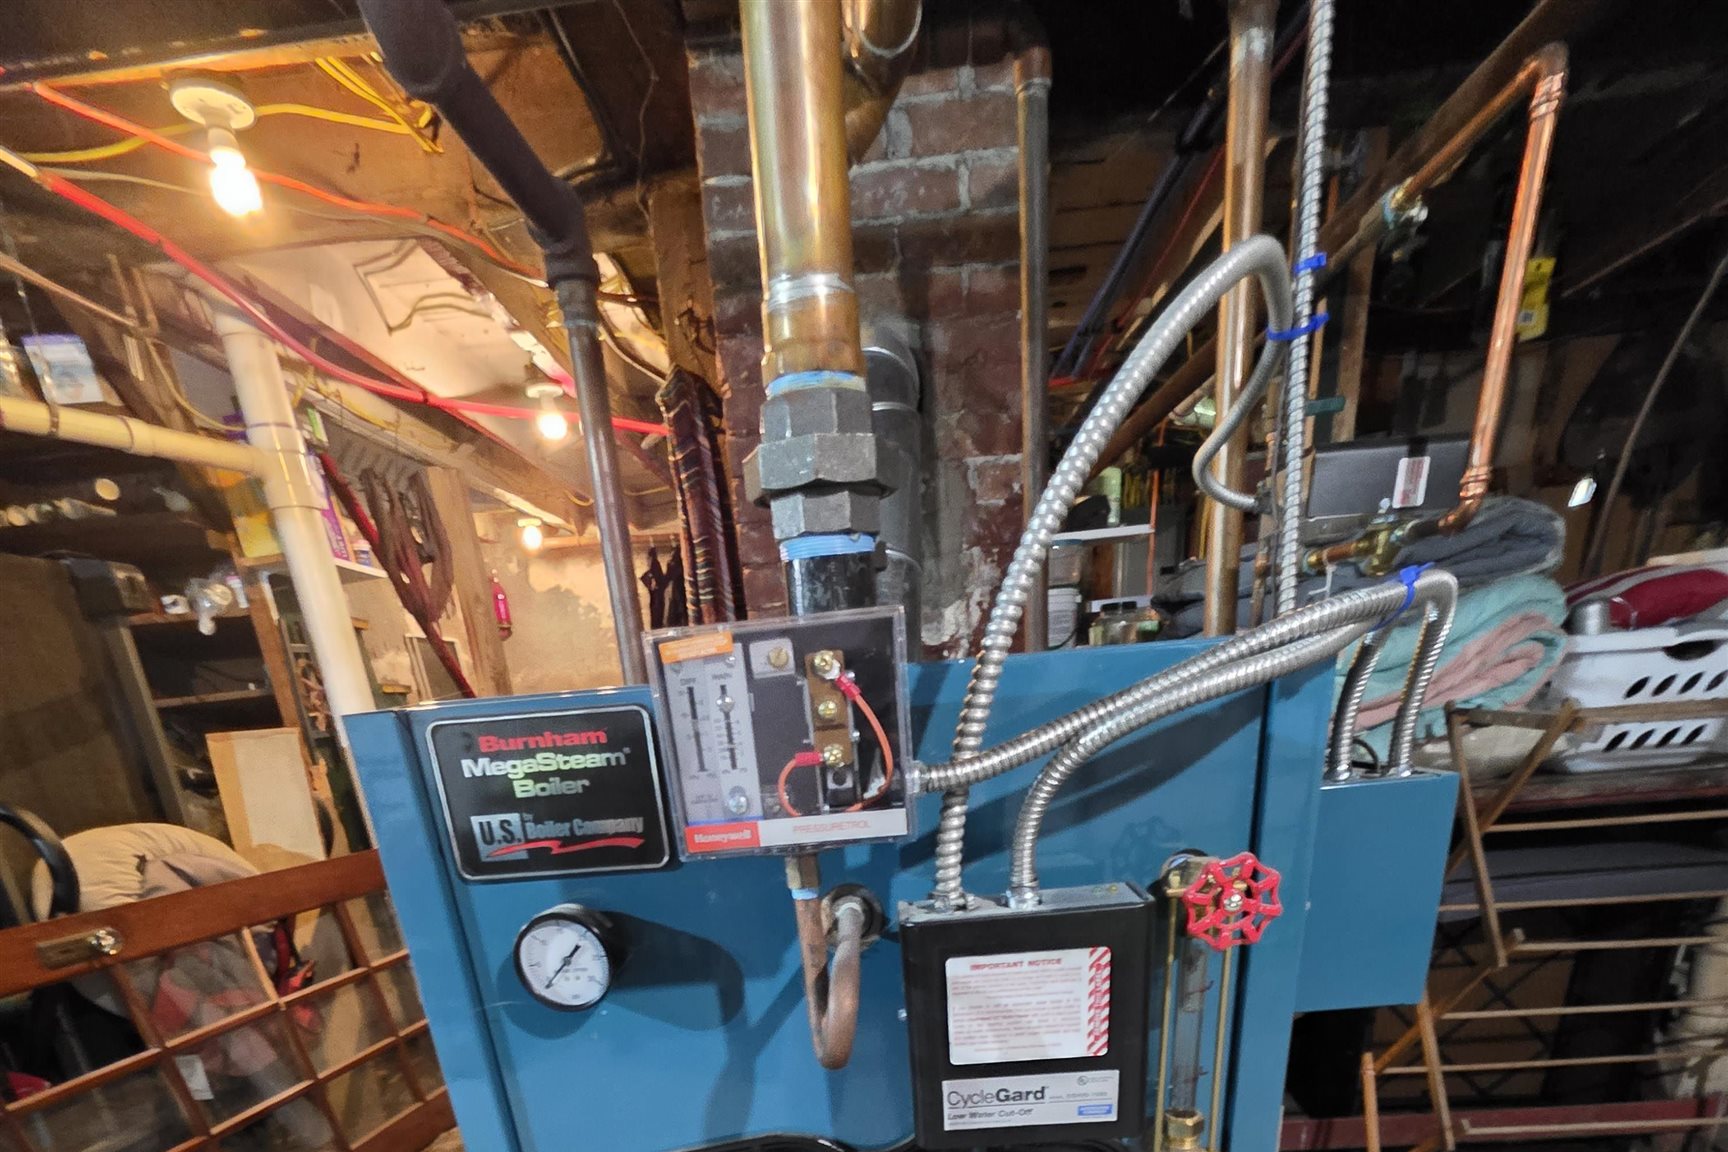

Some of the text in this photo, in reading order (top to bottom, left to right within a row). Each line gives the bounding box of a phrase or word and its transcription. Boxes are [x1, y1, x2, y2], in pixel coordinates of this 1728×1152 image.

[478, 729, 609, 753] Burnham
[512, 777, 591, 798] Boiler
[478, 816, 644, 845] U.S. Boiler Company
[694, 829, 752, 844] Honeywell
[970, 958, 1062, 971] IMPORTANT NOTICE
[947, 1086, 1046, 1108] CycleGard
[947, 1107, 1034, 1121] Low Water Cut-Off
